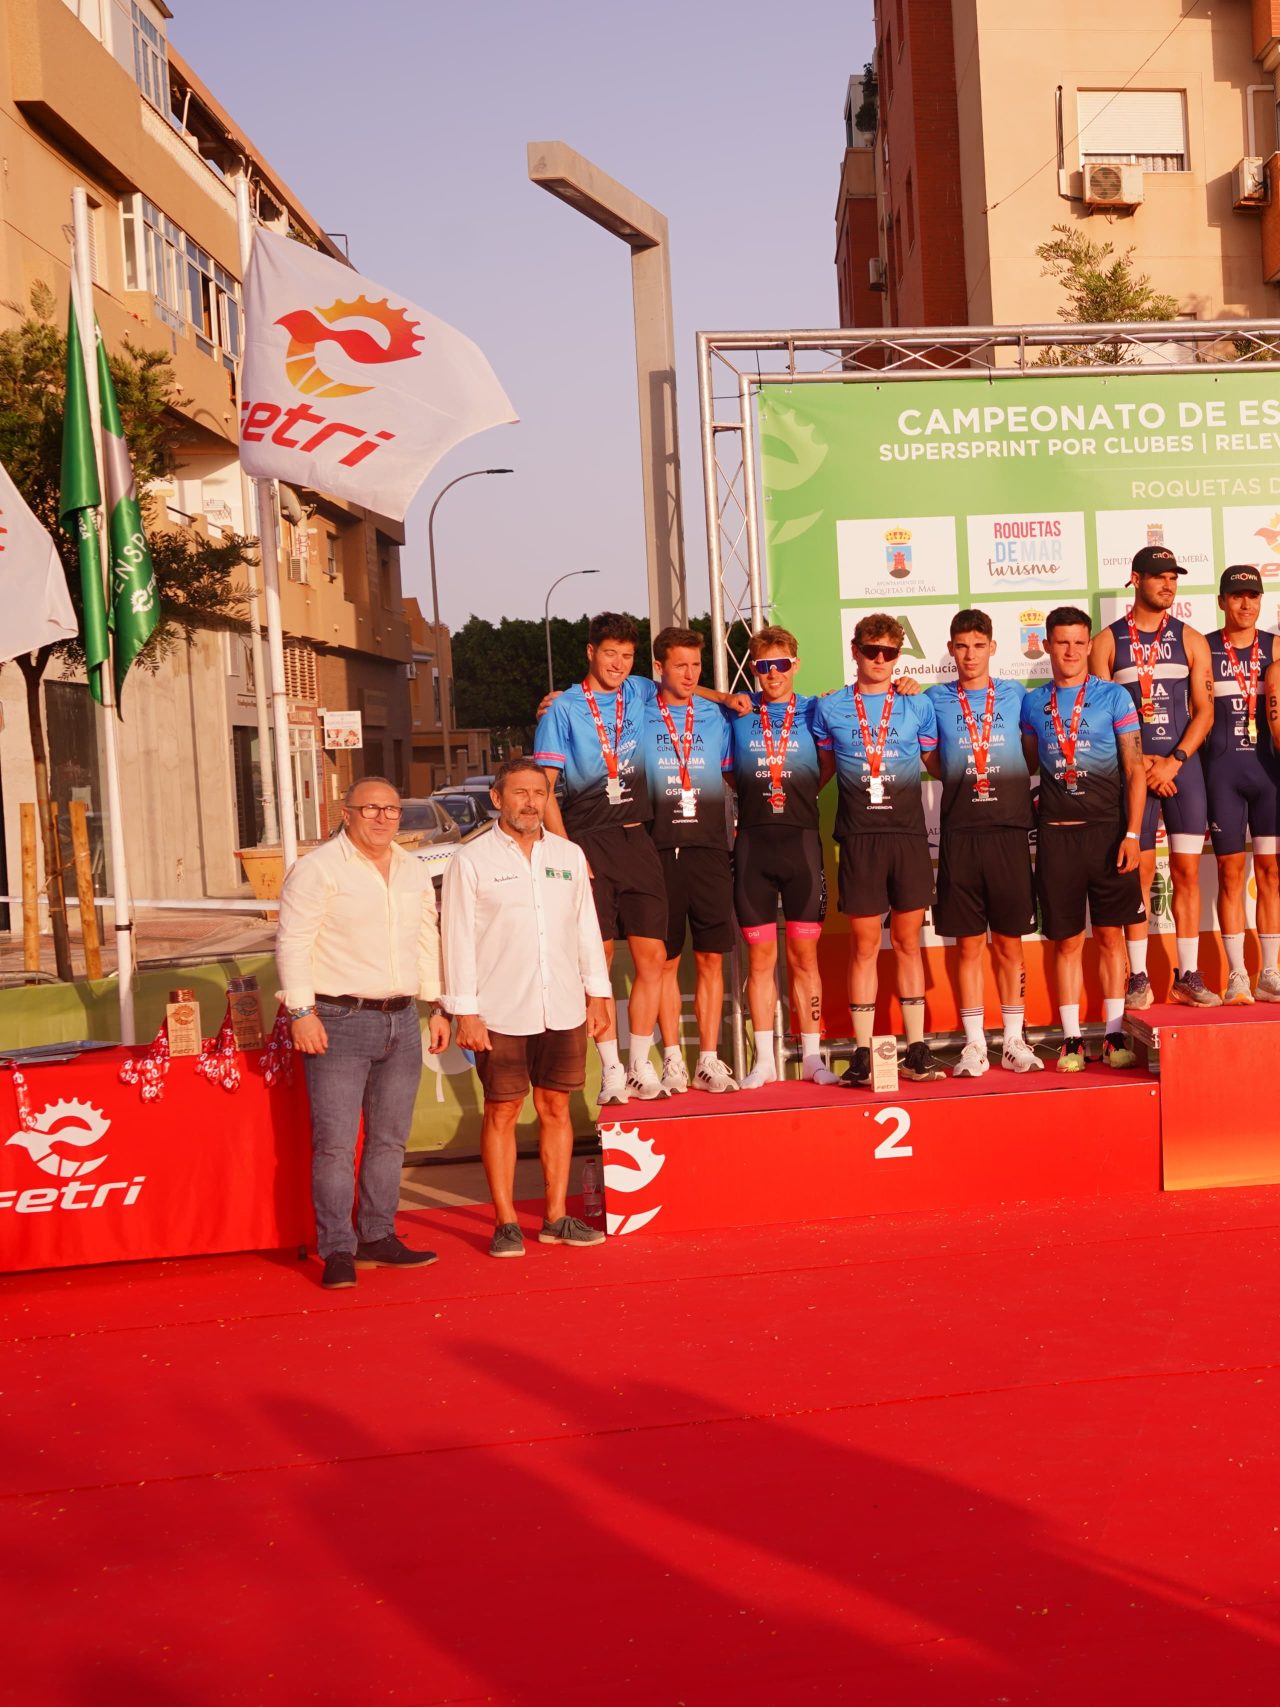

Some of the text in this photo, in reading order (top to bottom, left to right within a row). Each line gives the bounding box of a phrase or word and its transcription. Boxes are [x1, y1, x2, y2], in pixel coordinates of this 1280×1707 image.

[897, 402, 1166, 437] CAMPEONATO
[1178, 400, 1227, 428] DE
[241, 399, 397, 468] etri
[879, 439, 1041, 461] SUPERSPRINT
[1048, 437, 1097, 457] POR
[1103, 435, 1195, 455] CLUBES
[1131, 478, 1261, 499] ROQUETAS
[994, 520, 1062, 539] ROQUETAS
[995, 540, 1063, 563] DE MAR
[986, 558, 1061, 578] turismo
[1230, 573, 1258, 581] CROWN
[903, 661, 957, 676] Andalucía
[1269, 695, 1277, 708] 6
[811, 996, 820, 1008] 2
[873, 1106, 914, 1160] 2
